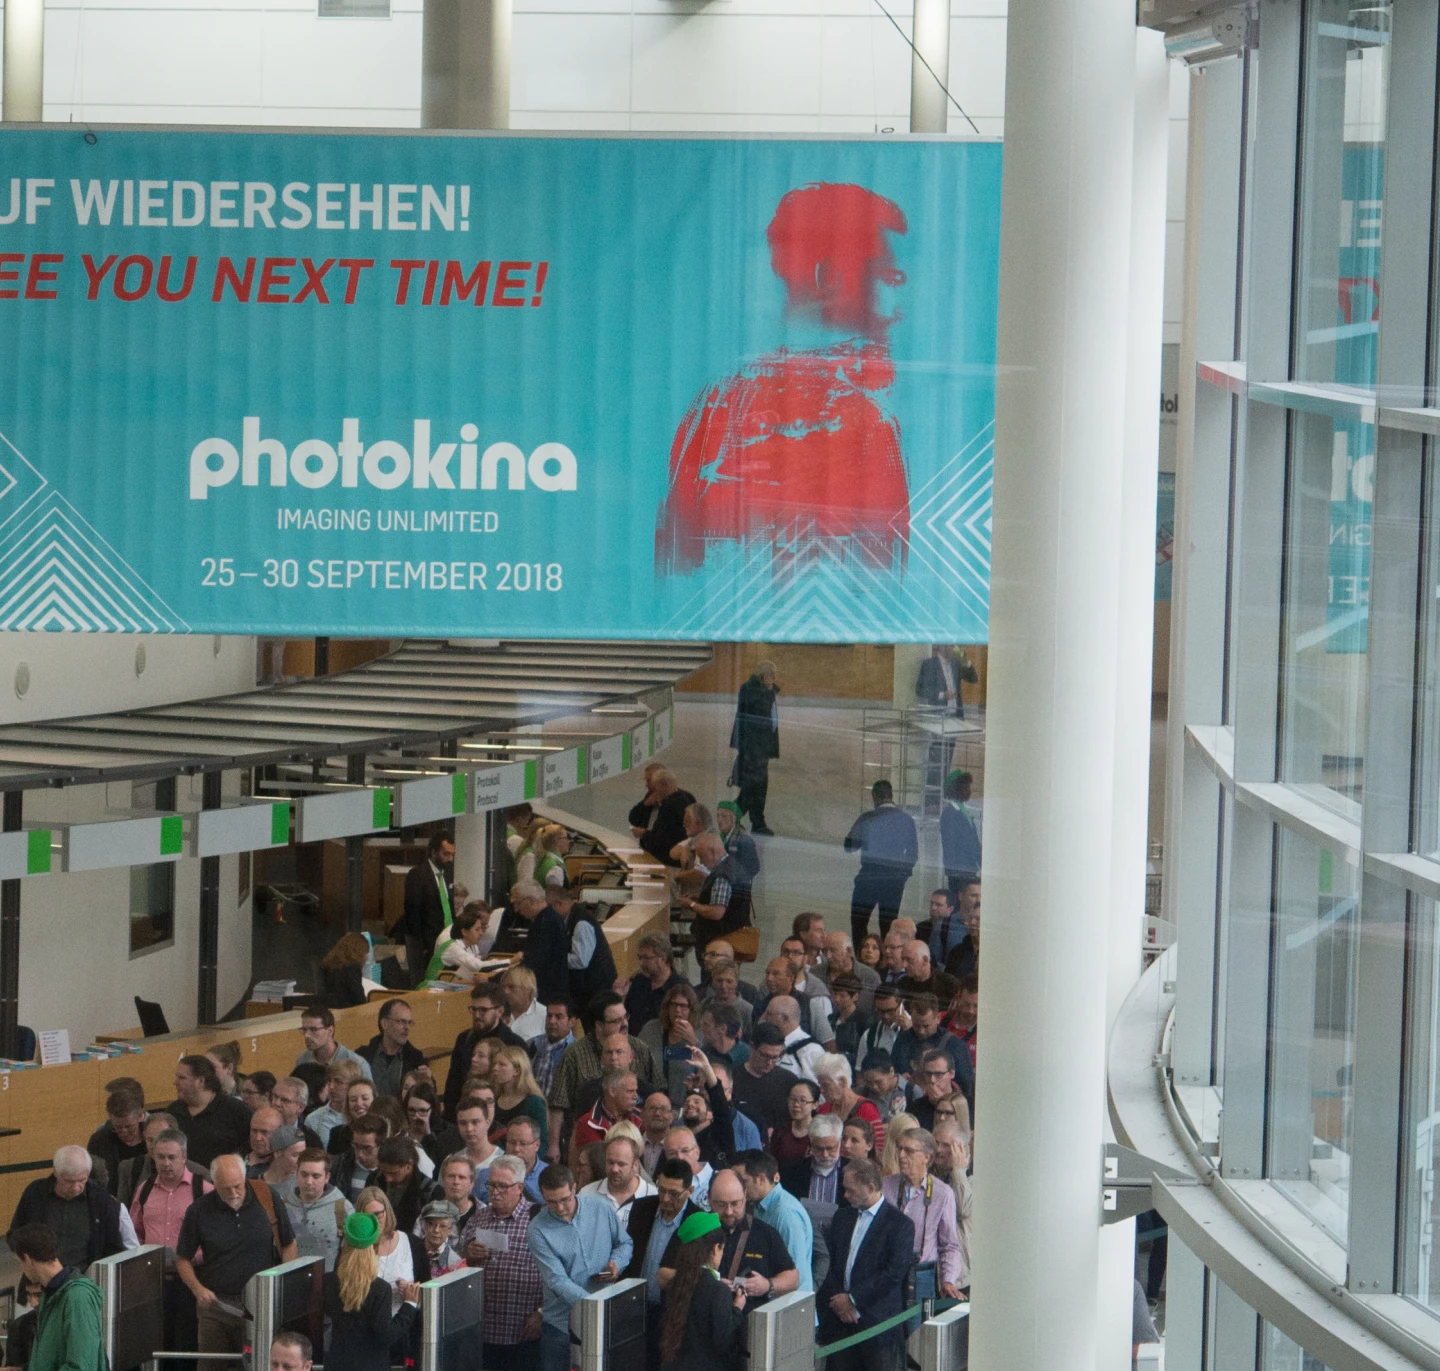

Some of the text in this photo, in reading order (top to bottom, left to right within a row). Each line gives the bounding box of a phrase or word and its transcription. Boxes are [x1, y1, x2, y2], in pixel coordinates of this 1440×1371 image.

[71, 179, 471, 233] WIEDERSEHEN!
[83, 255, 199, 303] YOU
[212, 257, 375, 306] NEXT
[391, 260, 549, 308] TIME!
[189, 417, 578, 501] photokina
[277, 509, 500, 534] IMAGING UNLIMITED
[307, 559, 488, 592] SEPTEMBER
[496, 562, 564, 593] 2018
[251, 1038, 257, 1053] 5
[2, 1076, 9, 1090] 3
